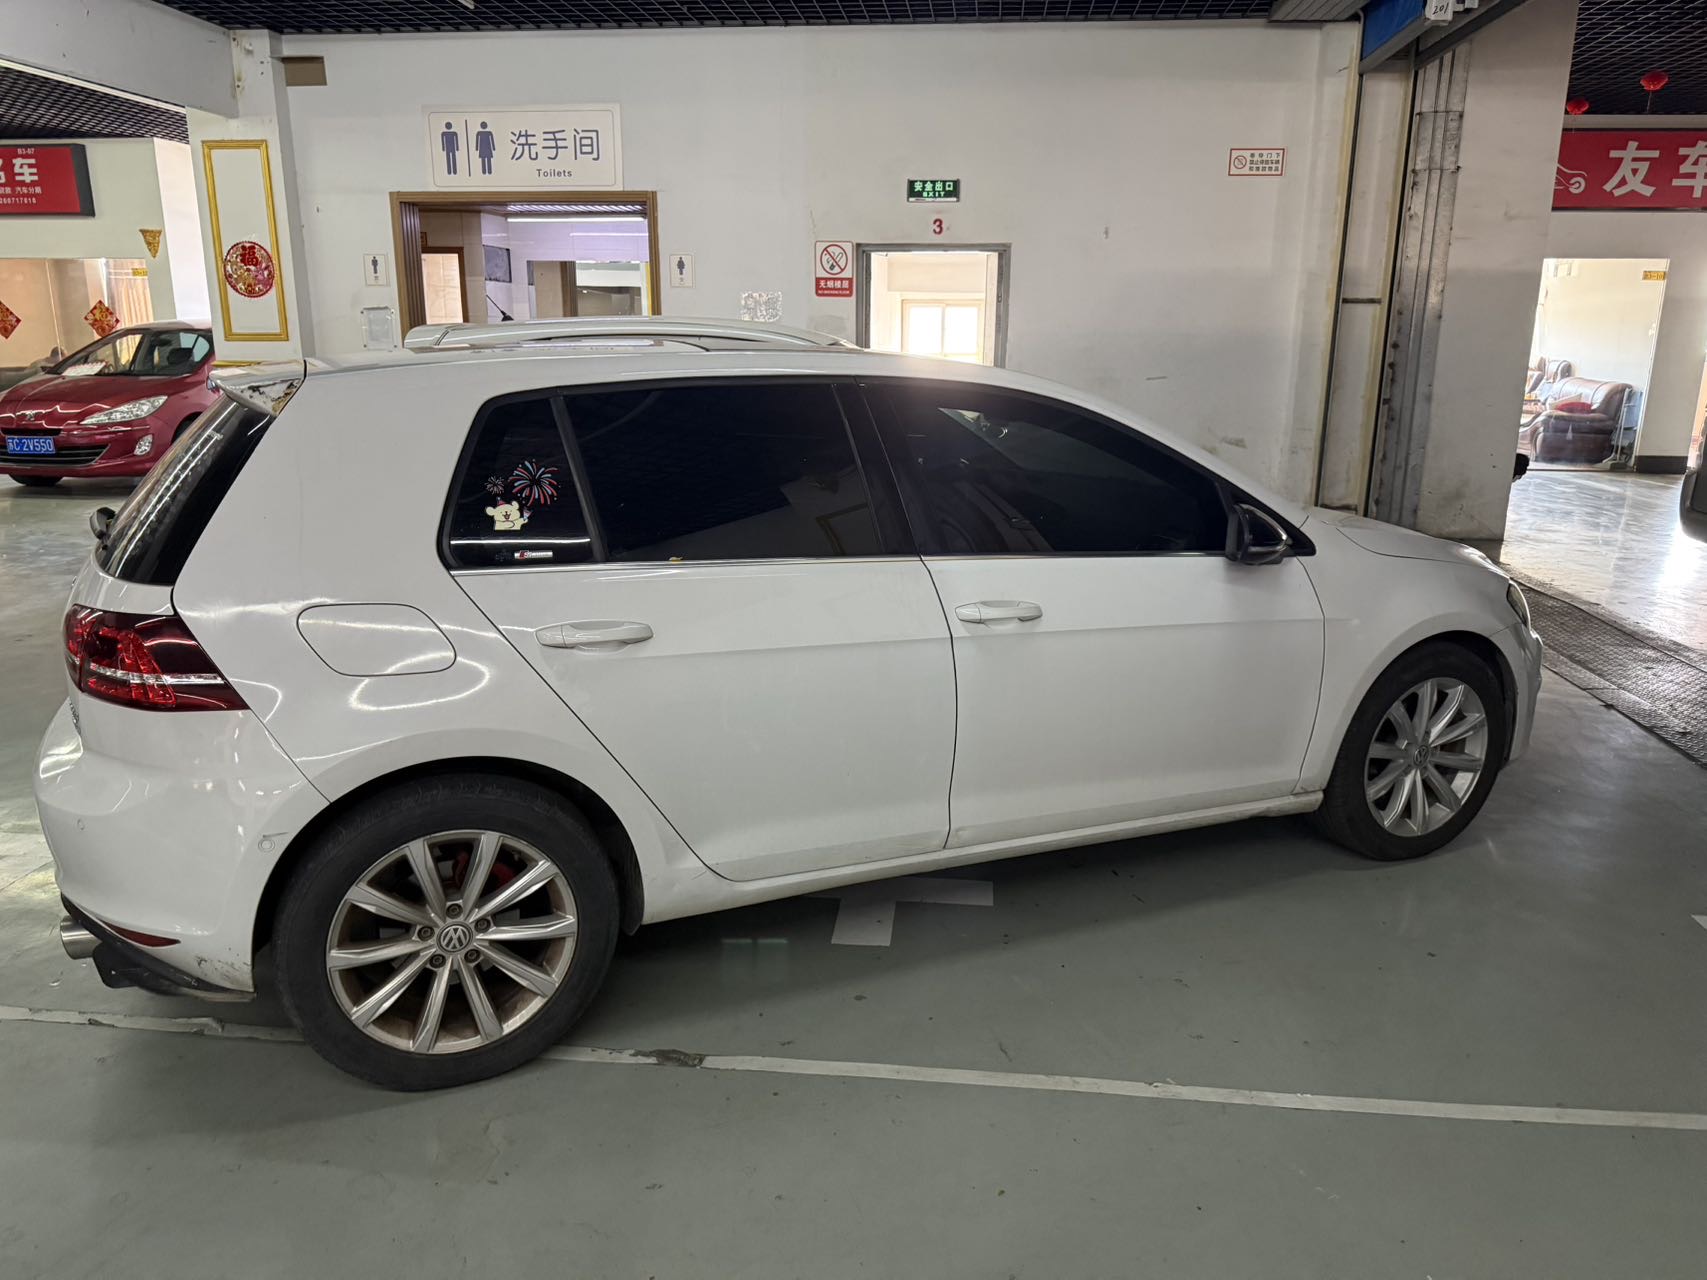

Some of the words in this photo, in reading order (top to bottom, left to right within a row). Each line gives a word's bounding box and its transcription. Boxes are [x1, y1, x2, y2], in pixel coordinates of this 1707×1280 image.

[510, 128, 600, 161] 洗手间
[536, 168, 573, 178] Toilets
[914, 180, 954, 192] 安全出口
[933, 218, 944, 236] 3
